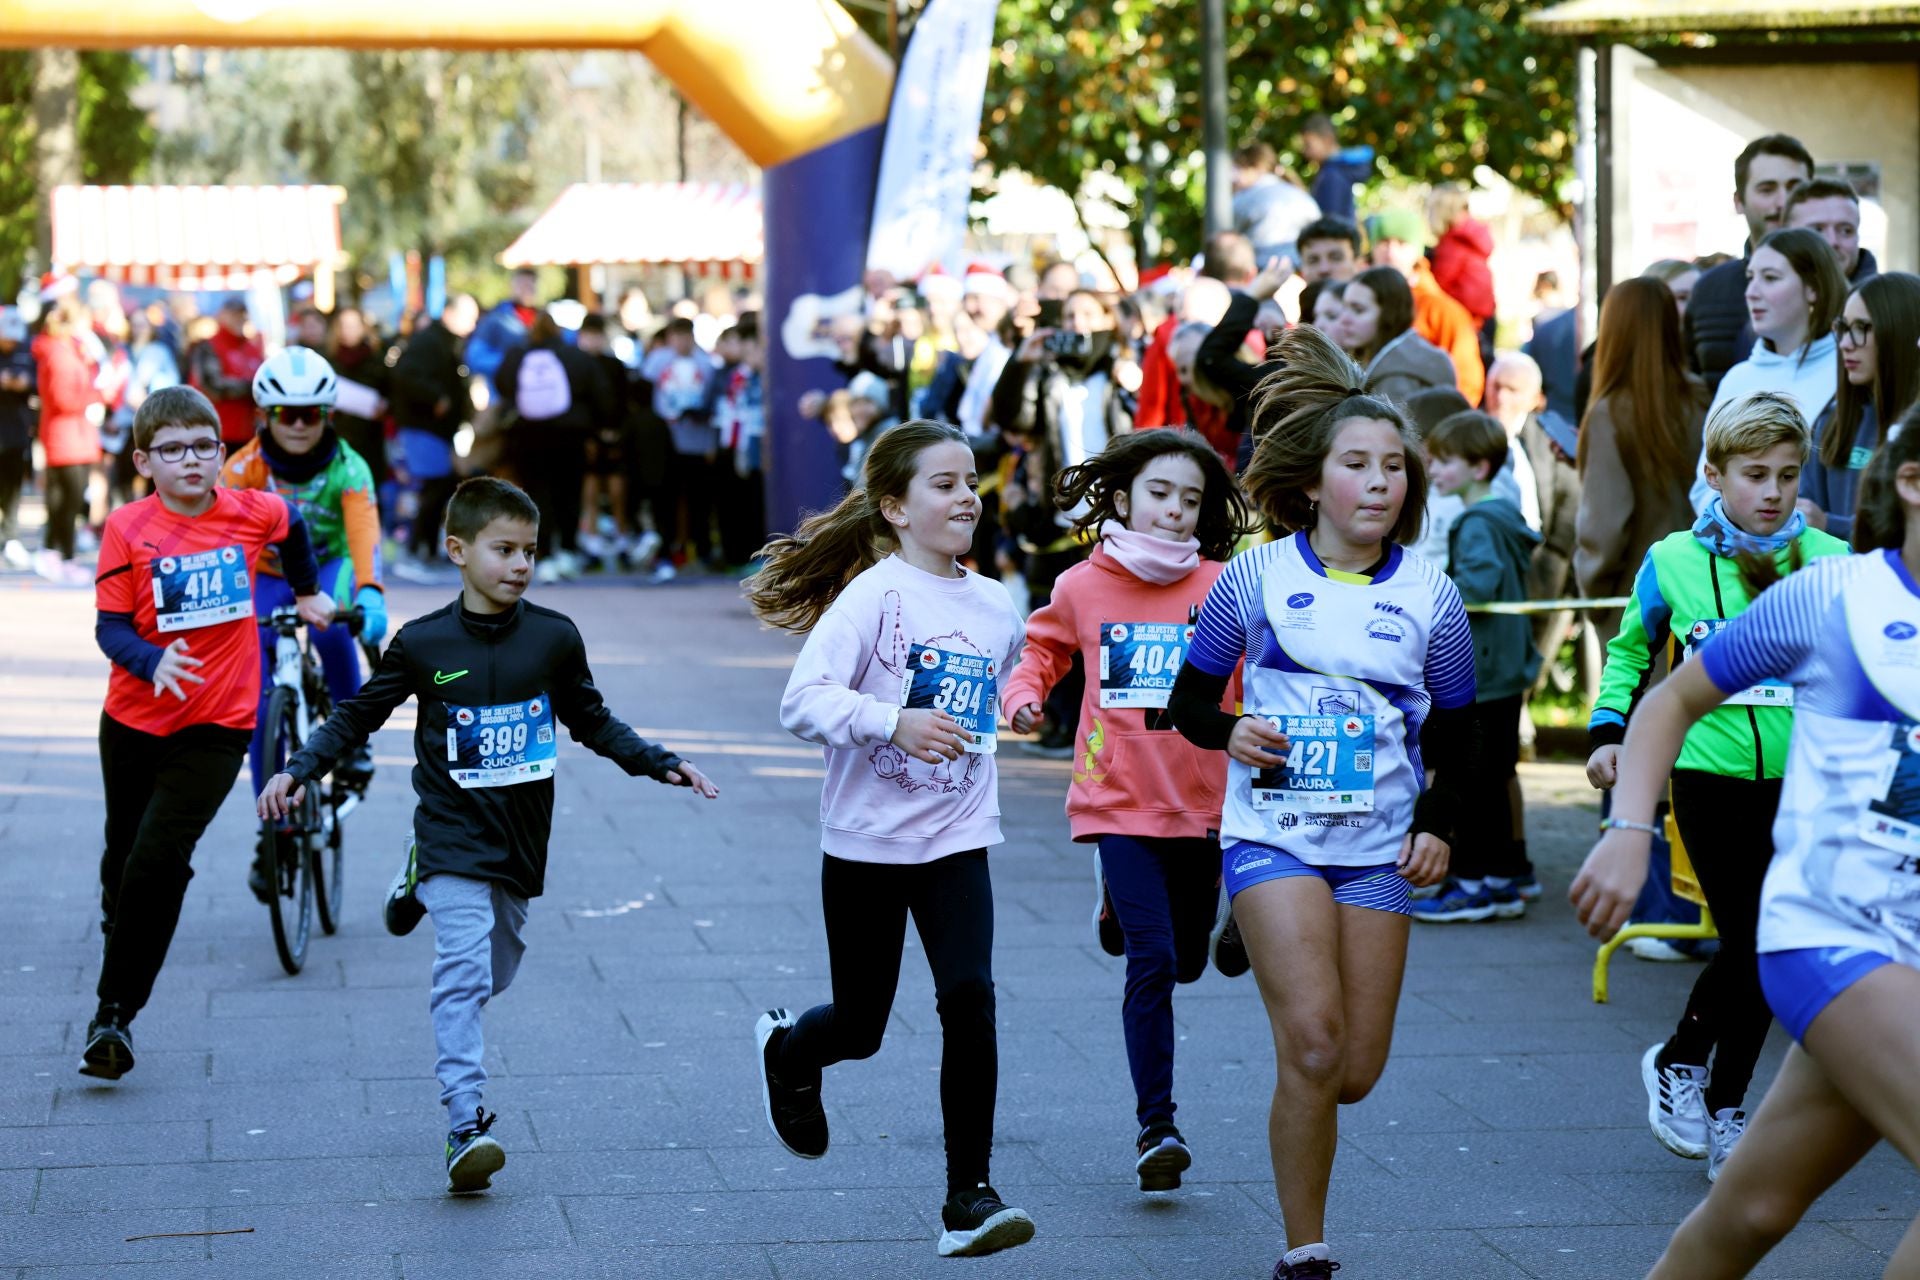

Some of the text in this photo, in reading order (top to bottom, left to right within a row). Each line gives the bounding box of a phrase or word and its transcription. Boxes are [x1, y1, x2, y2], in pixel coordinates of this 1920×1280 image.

[184, 568, 223, 600] 414
[181, 595, 229, 612] PELAYO P
[1134, 624, 1178, 634] SAN SILVESTRE
[1715, 621, 1727, 630] SAN
[1162, 634, 1178, 642] 2024
[948, 655, 984, 669] SAN SILVESTRE
[1129, 645, 1181, 676] 404
[972, 668, 984, 678] 2024
[933, 677, 984, 716] 394
[480, 704, 524, 717] SAN SILVESTRE
[509, 712, 525, 722] 2024
[1287, 717, 1336, 728] SAN SILVESTRE
[1318, 727, 1337, 737] 2024
[479, 723, 528, 757] 399
[482, 753, 526, 769] QUIQUE
[1286, 741, 1338, 776] 421
[1289, 778, 1334, 790] LAURA
[1235, 858, 1272, 874] CORVERA
